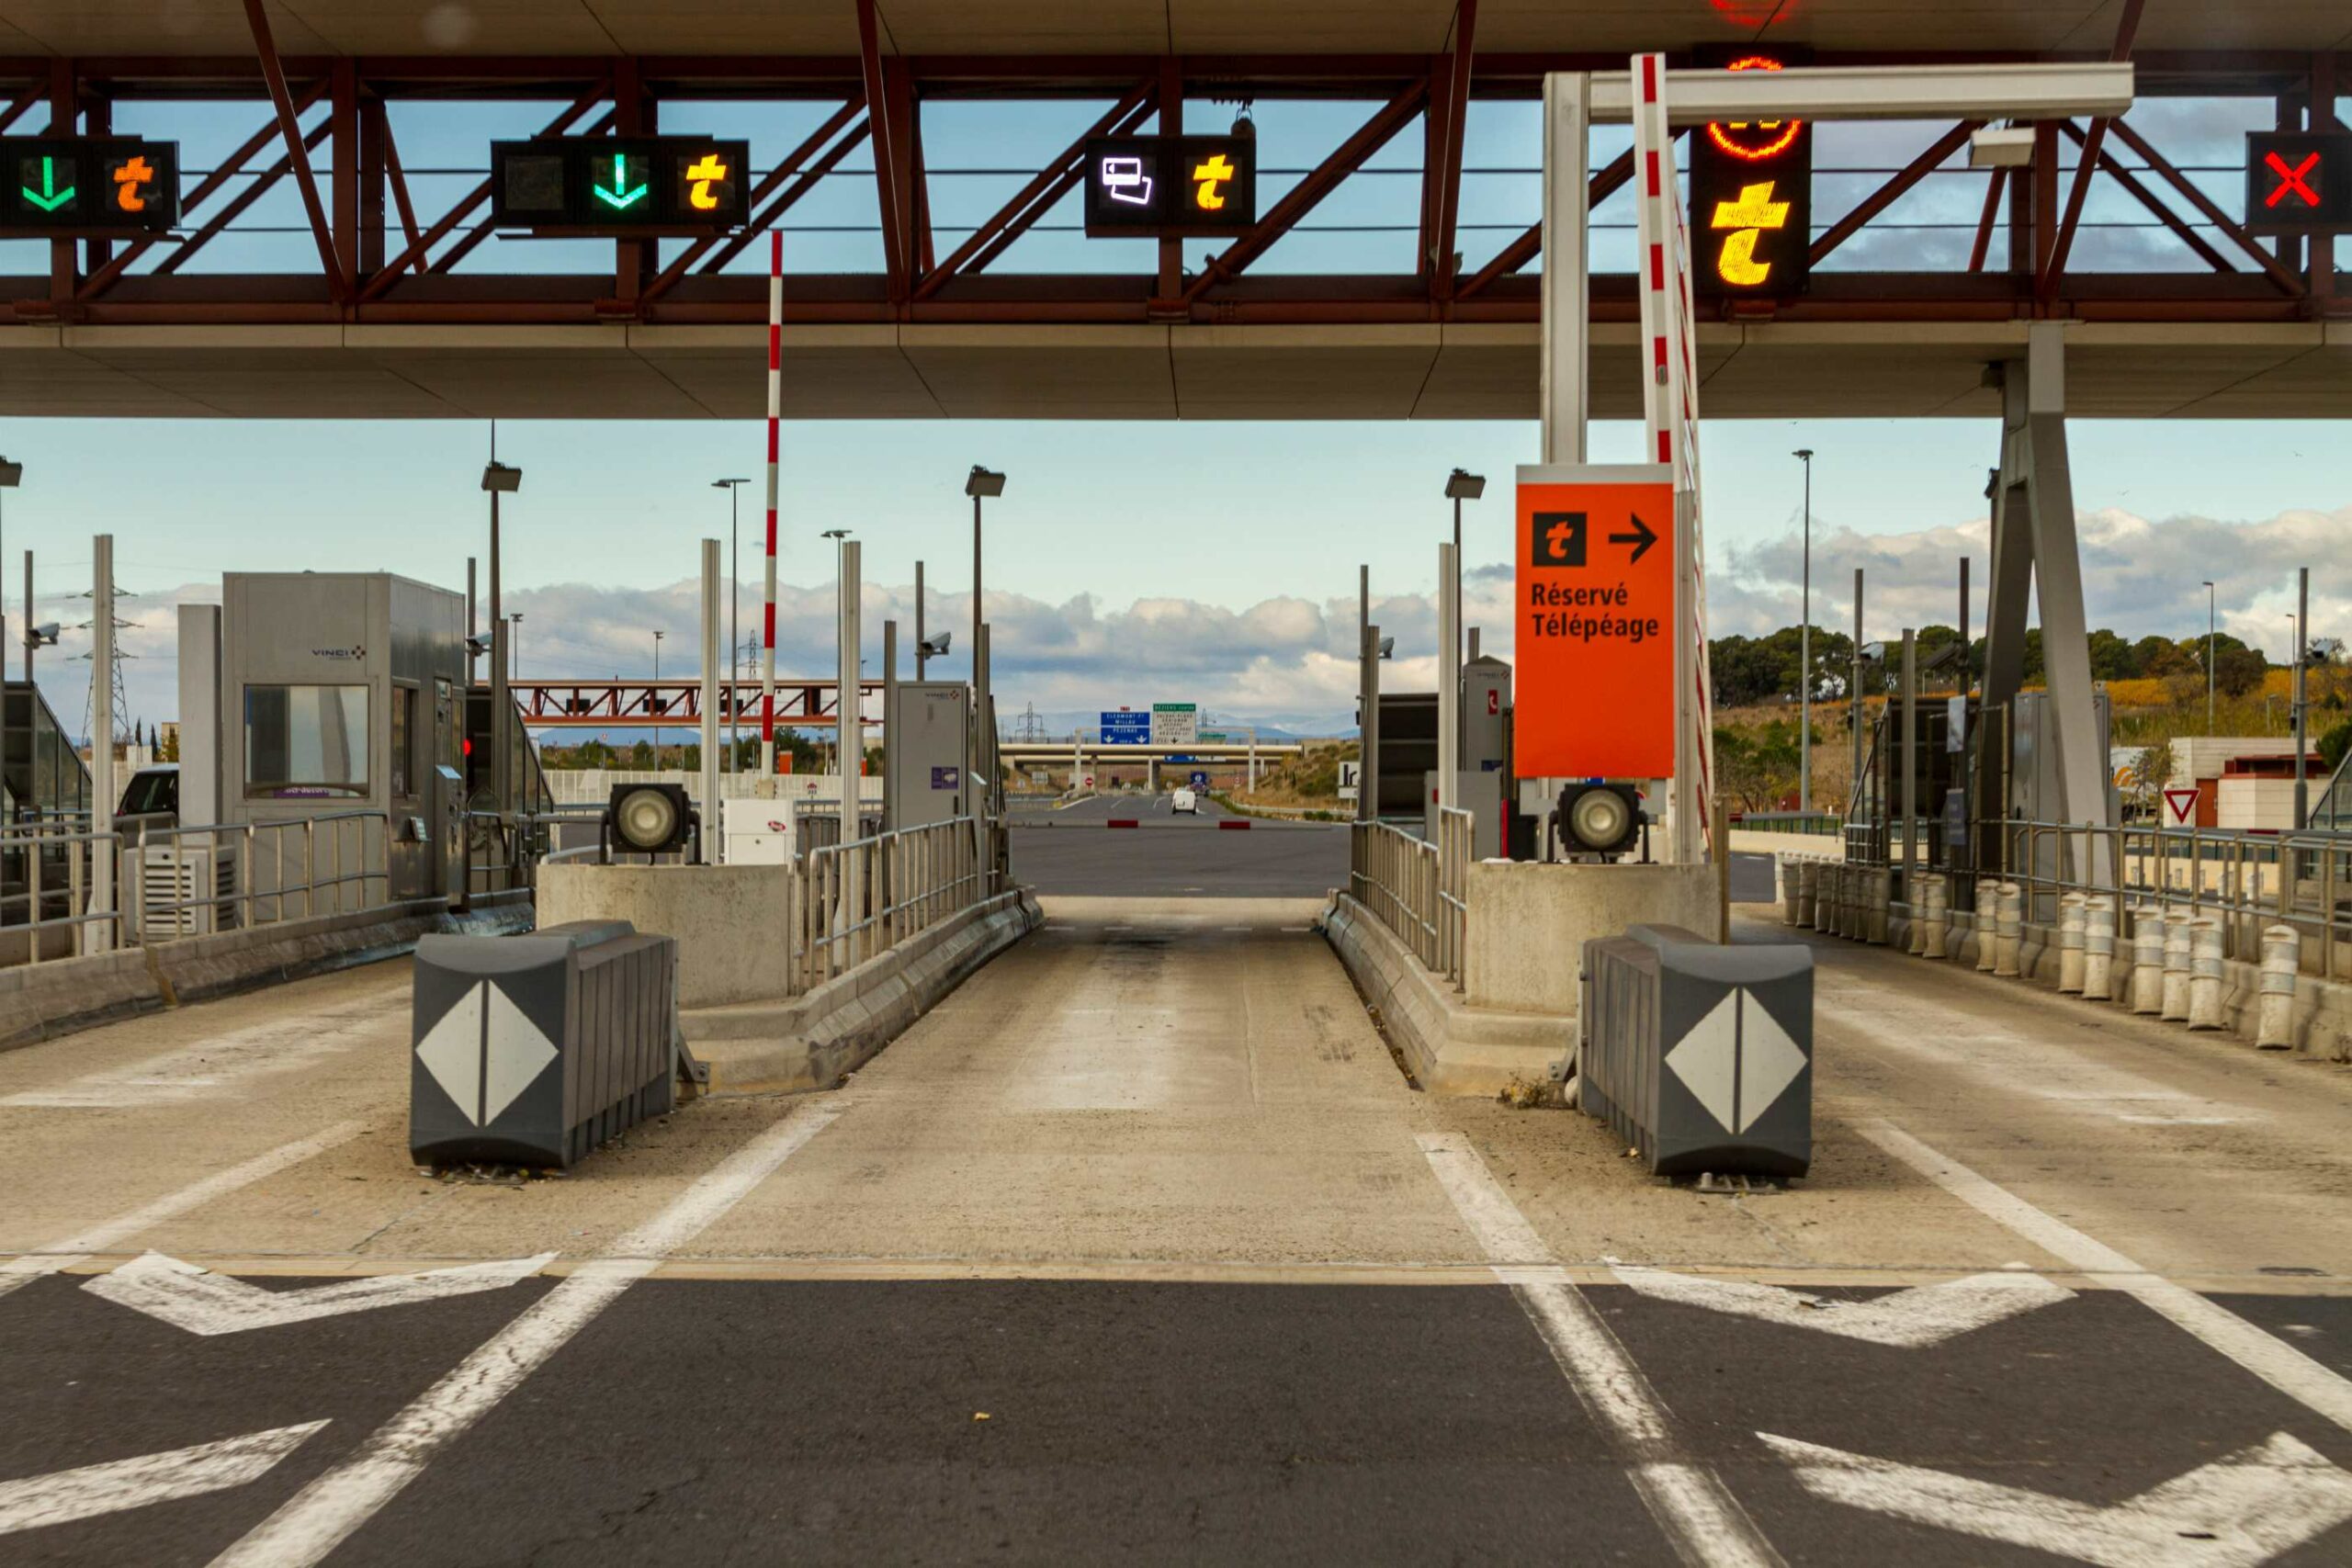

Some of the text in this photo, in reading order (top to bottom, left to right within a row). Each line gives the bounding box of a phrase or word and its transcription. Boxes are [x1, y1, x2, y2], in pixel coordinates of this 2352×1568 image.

[1532, 581, 1628, 606] Réservé
[1532, 612, 1658, 643] Télépéage
[311, 649, 349, 657] VINCI
